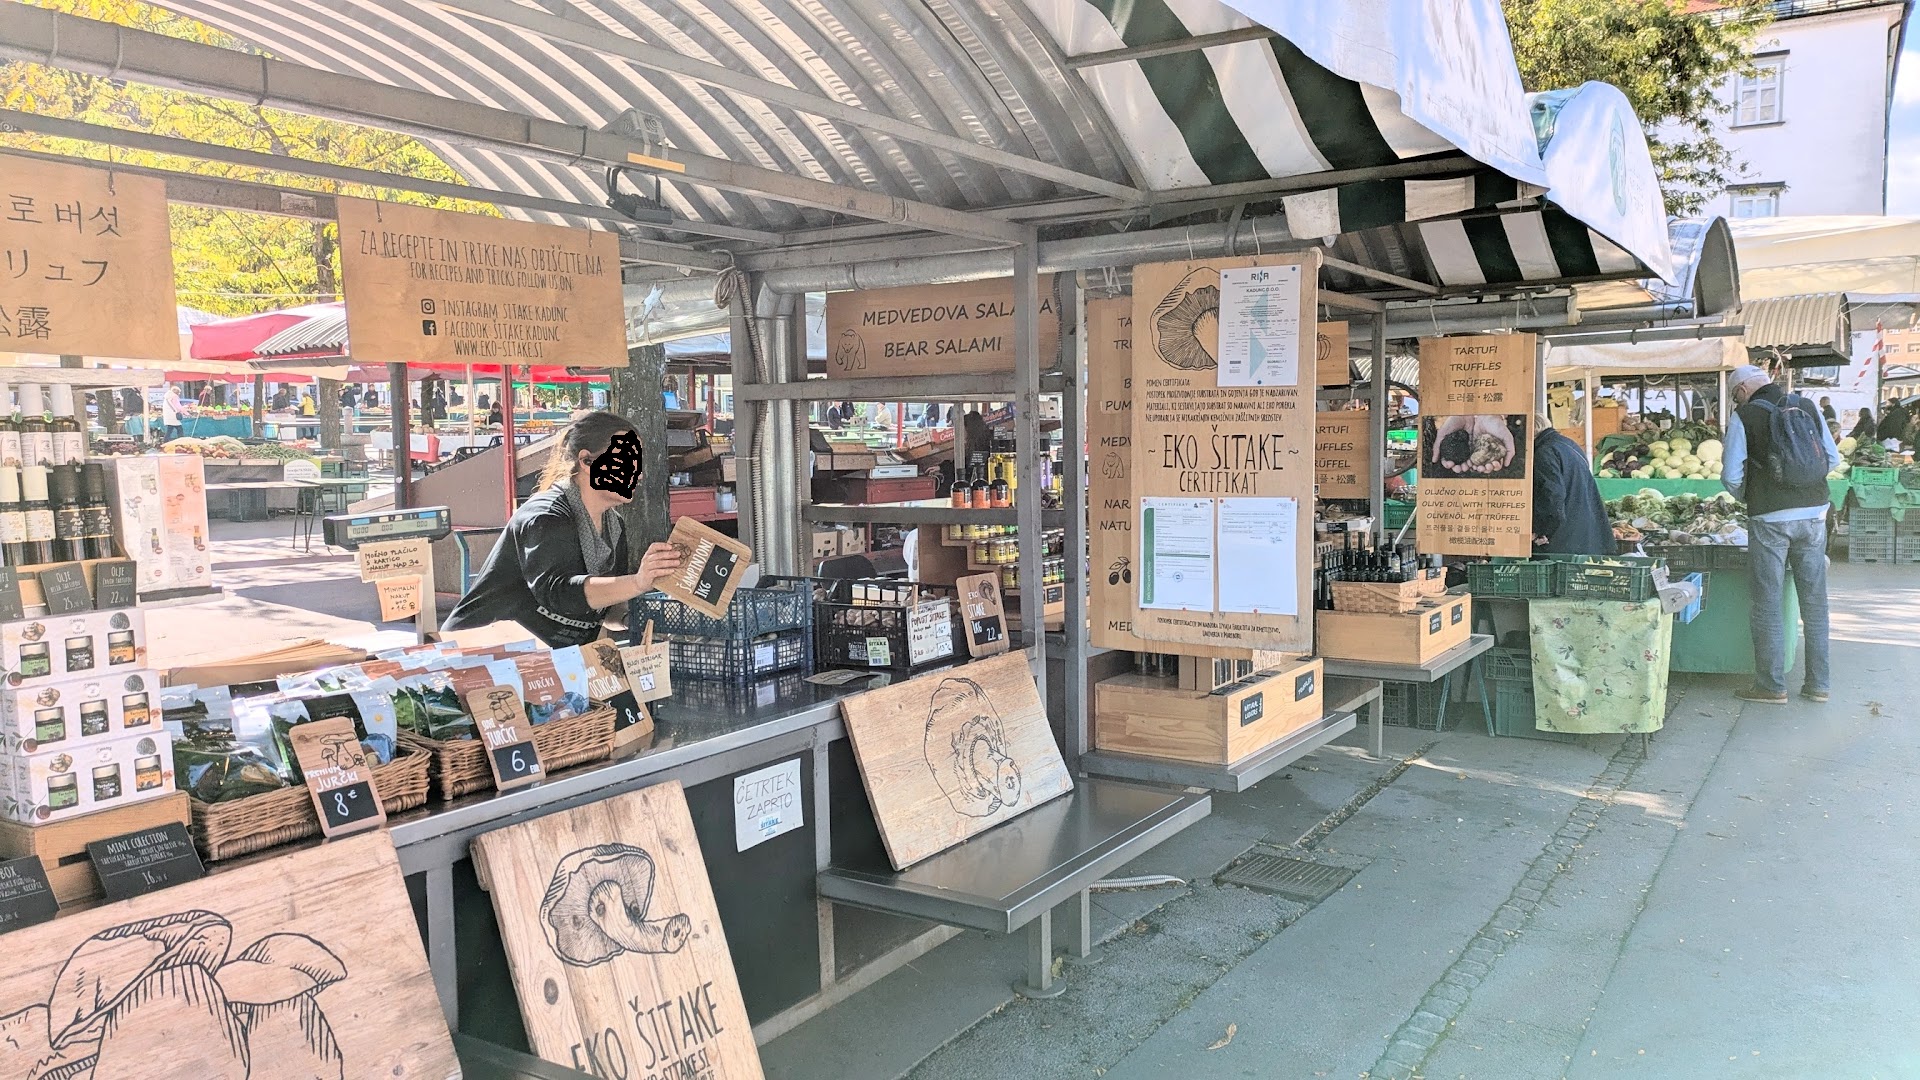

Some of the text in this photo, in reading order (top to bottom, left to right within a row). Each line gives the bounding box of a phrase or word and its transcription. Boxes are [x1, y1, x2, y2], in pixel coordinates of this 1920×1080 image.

[361, 230, 378, 256] ZA
[382, 231, 436, 260] RECEPTE
[439, 238, 458, 262] IN
[462, 241, 498, 267] TRIKE
[502, 246, 527, 271] NAS
[531, 244, 582, 275] OBIŠČITE
[410, 262, 428, 280] FOR
[429, 263, 463, 283] RECIPES
[465, 267, 484, 284] AND
[486, 268, 515, 287] TRICKS
[517, 271, 547, 289] FOLLOW
[549, 274, 558, 290] US
[535, 306, 569, 322] KADUNC
[862, 298, 1053, 326] MEDVEDOVA SALA
[493, 319, 523, 340] ŠITAKE
[526, 325, 560, 341] KADUNC
[884, 336, 1002, 358] BEAR SALAMI
[1454, 345, 1498, 356] TARTUFI
[1449, 361, 1502, 372] TRUFFLES
[1452, 378, 1498, 388] TRÜFFEL
[1163, 424, 1285, 471] EKO ŠITAKE
[1179, 470, 1258, 494] CERTIFIKAT
[1458, 488, 1479, 496] OLJE
[1489, 489, 1523, 497] TARTUFI
[1104, 499, 1131, 510] NAR
[1462, 501, 1483, 509] WITH
[1426, 511, 1521, 521] OLIVENÖL MIT TRÜFFEL
[110, 566, 125, 577] OLJE
[676, 537, 714, 594] ŠAMPINJONI
[715, 564, 729, 578] 6
[55, 571, 72, 583] OLJE
[384, 585, 417, 593] MINIMALNI
[986, 627, 997, 642] 22
[528, 676, 555, 690] JURČKI
[625, 707, 636, 723] 8
[485, 723, 519, 751] JURČKI
[511, 750, 526, 772] 6
[316, 770, 359, 793] JURČKI
[736, 771, 795, 804] ČETRTEK
[334, 789, 358, 816] 8 €
[747, 792, 793, 820] ZAPRTO
[106, 831, 169, 854] MINI COLECTION
[0, 866, 17, 880] BOX
[22, 881, 43, 892] RECEPTI
[571, 981, 724, 1080] EKO ŠITAKE
